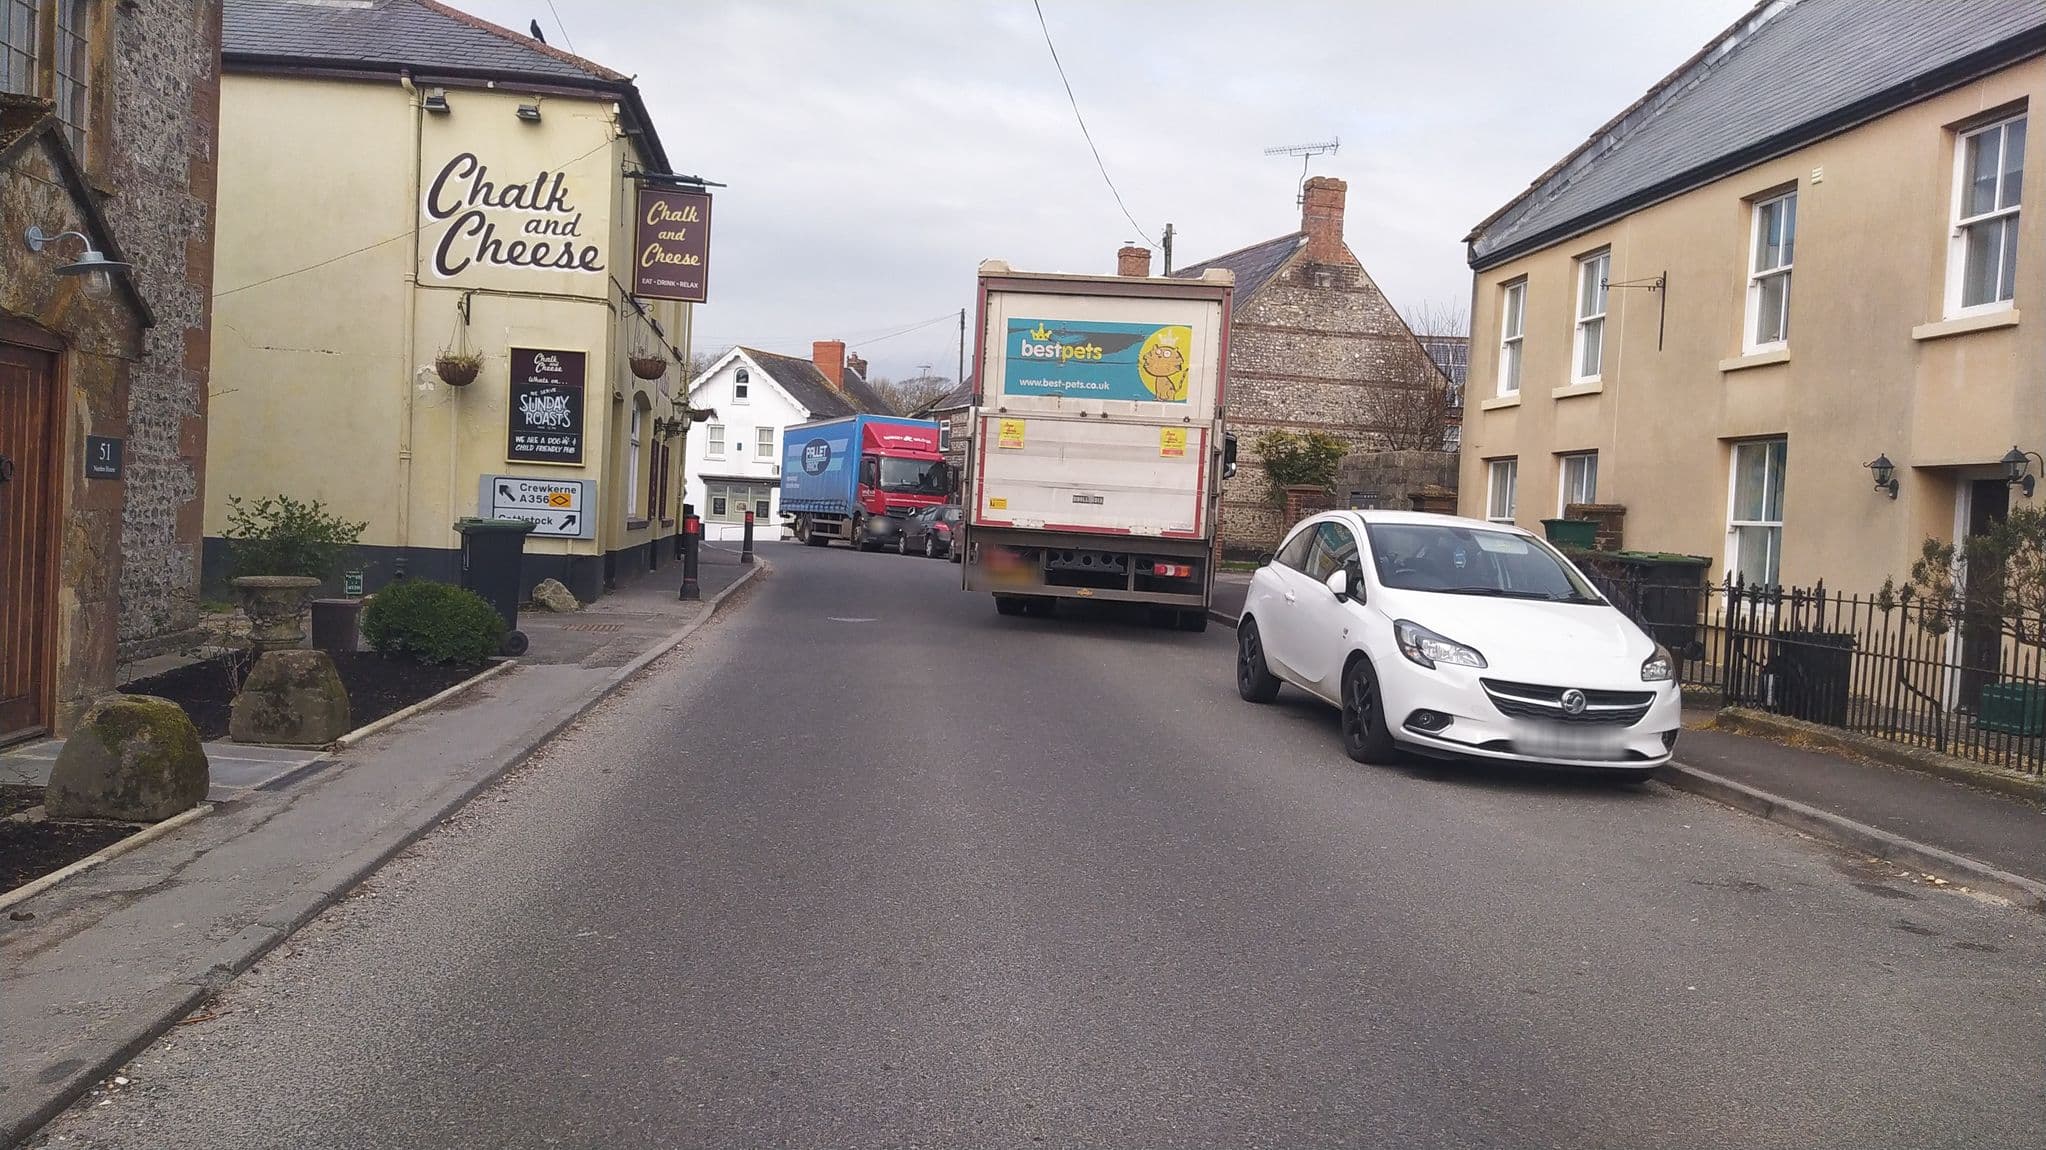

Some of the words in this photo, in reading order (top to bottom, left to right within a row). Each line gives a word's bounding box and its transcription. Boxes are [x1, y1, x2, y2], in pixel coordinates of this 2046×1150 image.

[427, 152, 575, 220] Chalk
[647, 200, 700, 225] Chalk
[524, 213, 582, 237] and
[658, 228, 686, 241] and
[435, 210, 605, 277] Cheese
[642, 243, 701, 268] Cheese
[657, 279, 676, 287] DRINK
[680, 280, 698, 289] RELAX
[1021, 339, 1103, 363] bestpets
[1019, 378, 1110, 391] www.best-pets.co.uk
[519, 394, 570, 413] SUNDAY
[525, 409, 571, 428] ROASTS
[99, 443, 111, 460] 51
[519, 483, 577, 494] Crewkerne
[519, 494, 550, 504] A356
